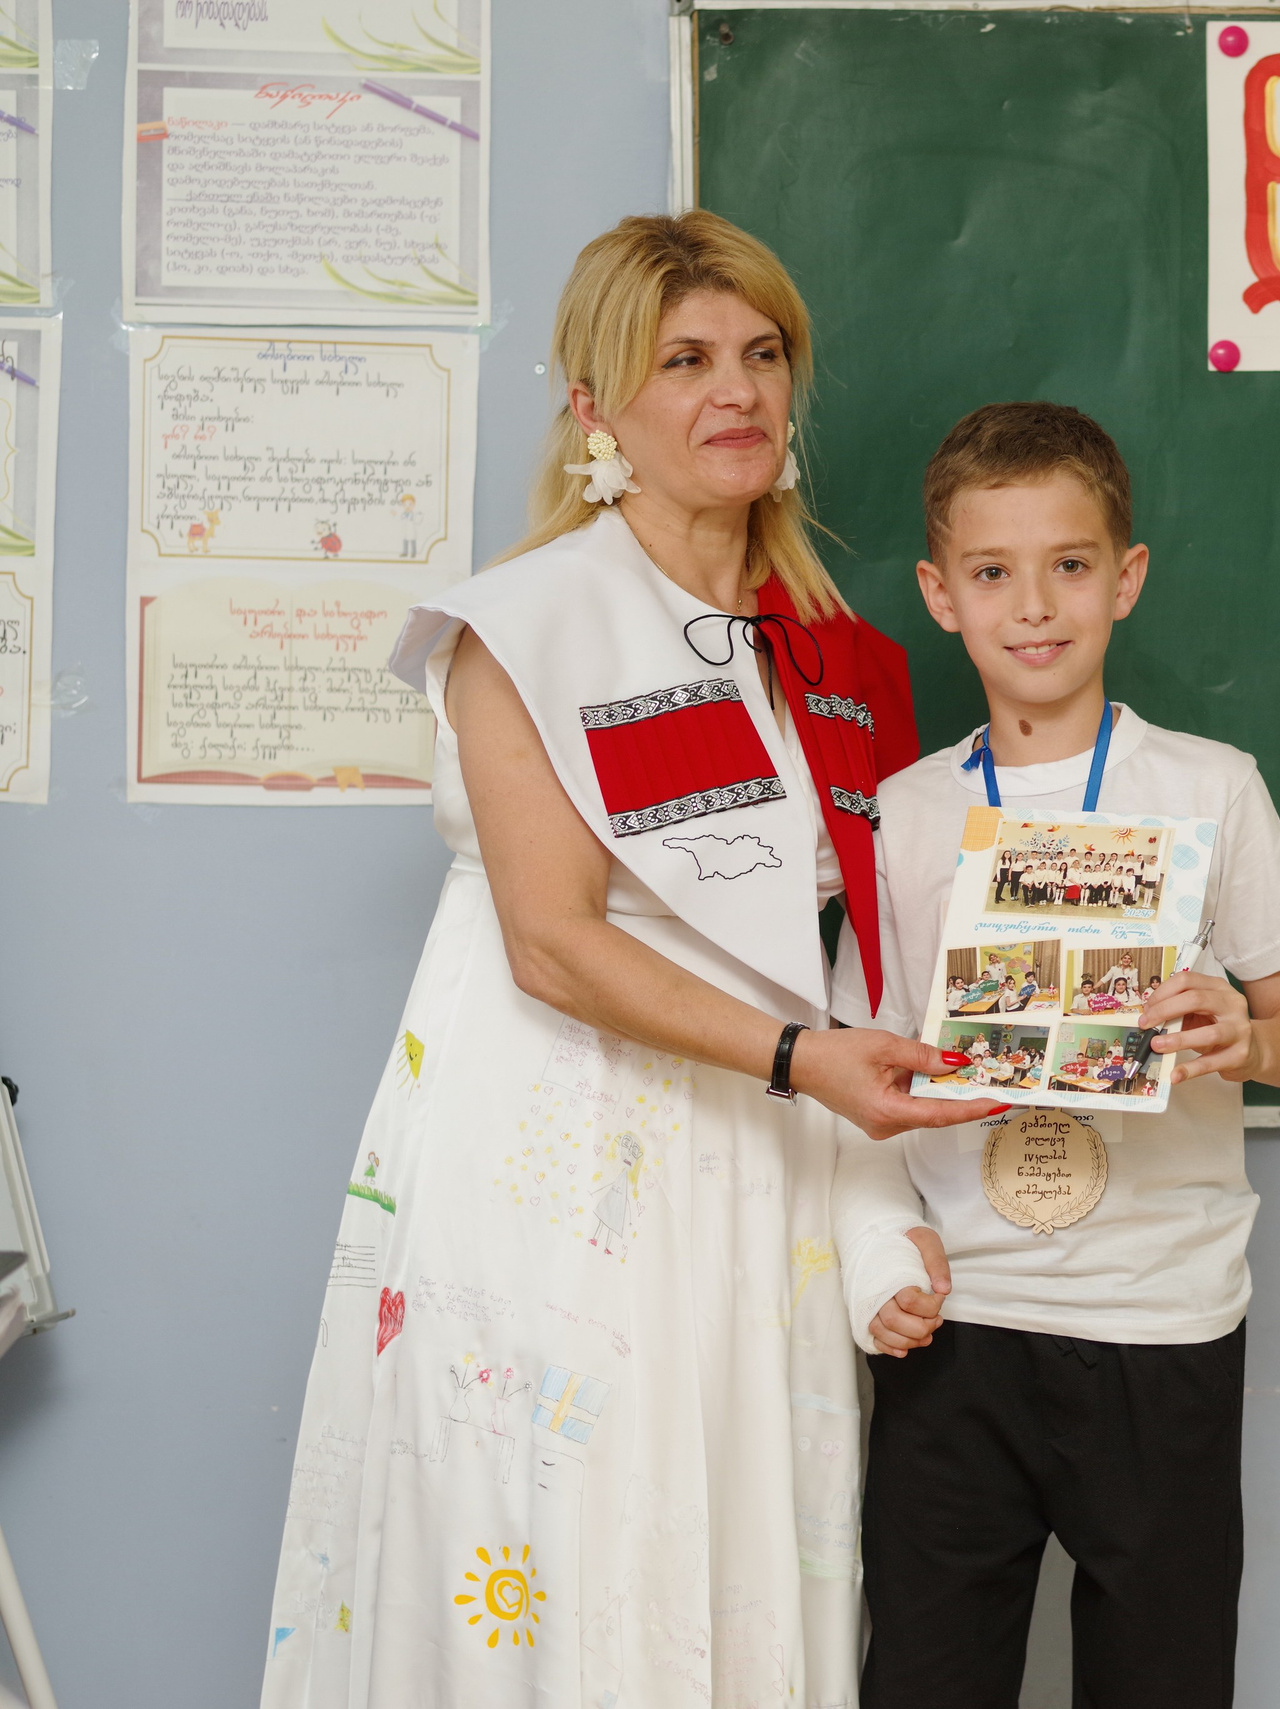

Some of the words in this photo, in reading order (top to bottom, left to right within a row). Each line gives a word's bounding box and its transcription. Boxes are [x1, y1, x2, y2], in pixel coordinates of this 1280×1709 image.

[167, 162, 185, 172] და
[1020, 1115, 1071, 1135] გაბრიელ
[1024, 1136, 1066, 1147] გილოცავ
[1017, 1166, 1072, 1182] წარმატებით
[1015, 1183, 1072, 1203] დასრულებას
